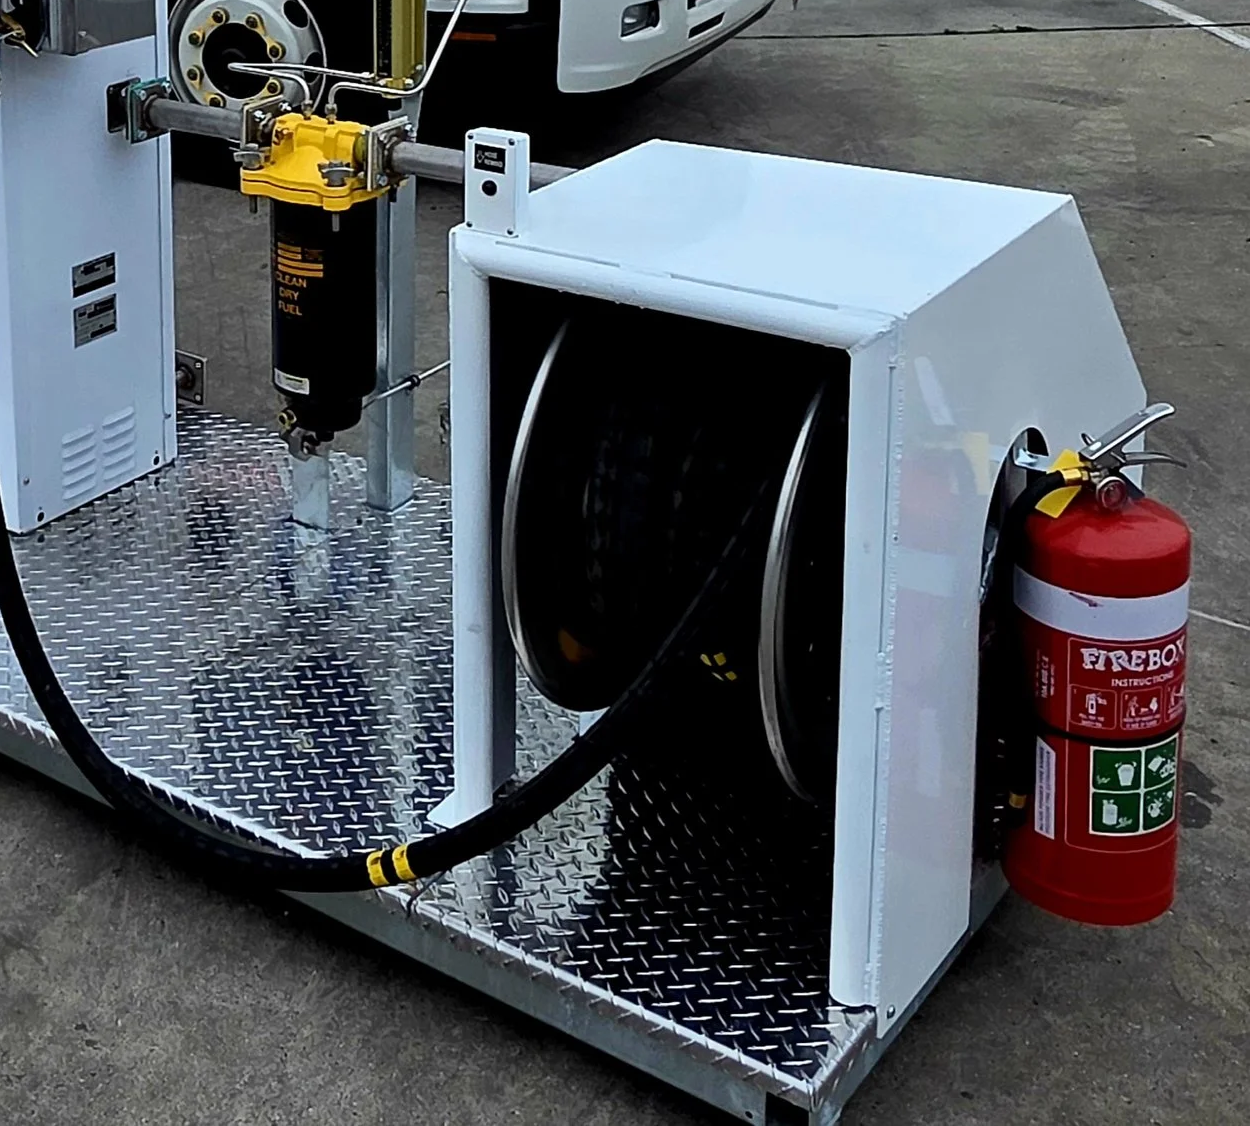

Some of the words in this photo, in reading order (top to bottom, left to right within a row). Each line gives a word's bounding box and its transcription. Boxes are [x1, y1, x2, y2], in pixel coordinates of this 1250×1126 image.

[275, 271, 307, 288] CLEAN
[279, 286, 300, 301] DRY
[278, 300, 303, 316] FUEL
[1080, 635, 1185, 672] FIREBOX
[1111, 670, 1174, 687] INSTRUCTIONS
